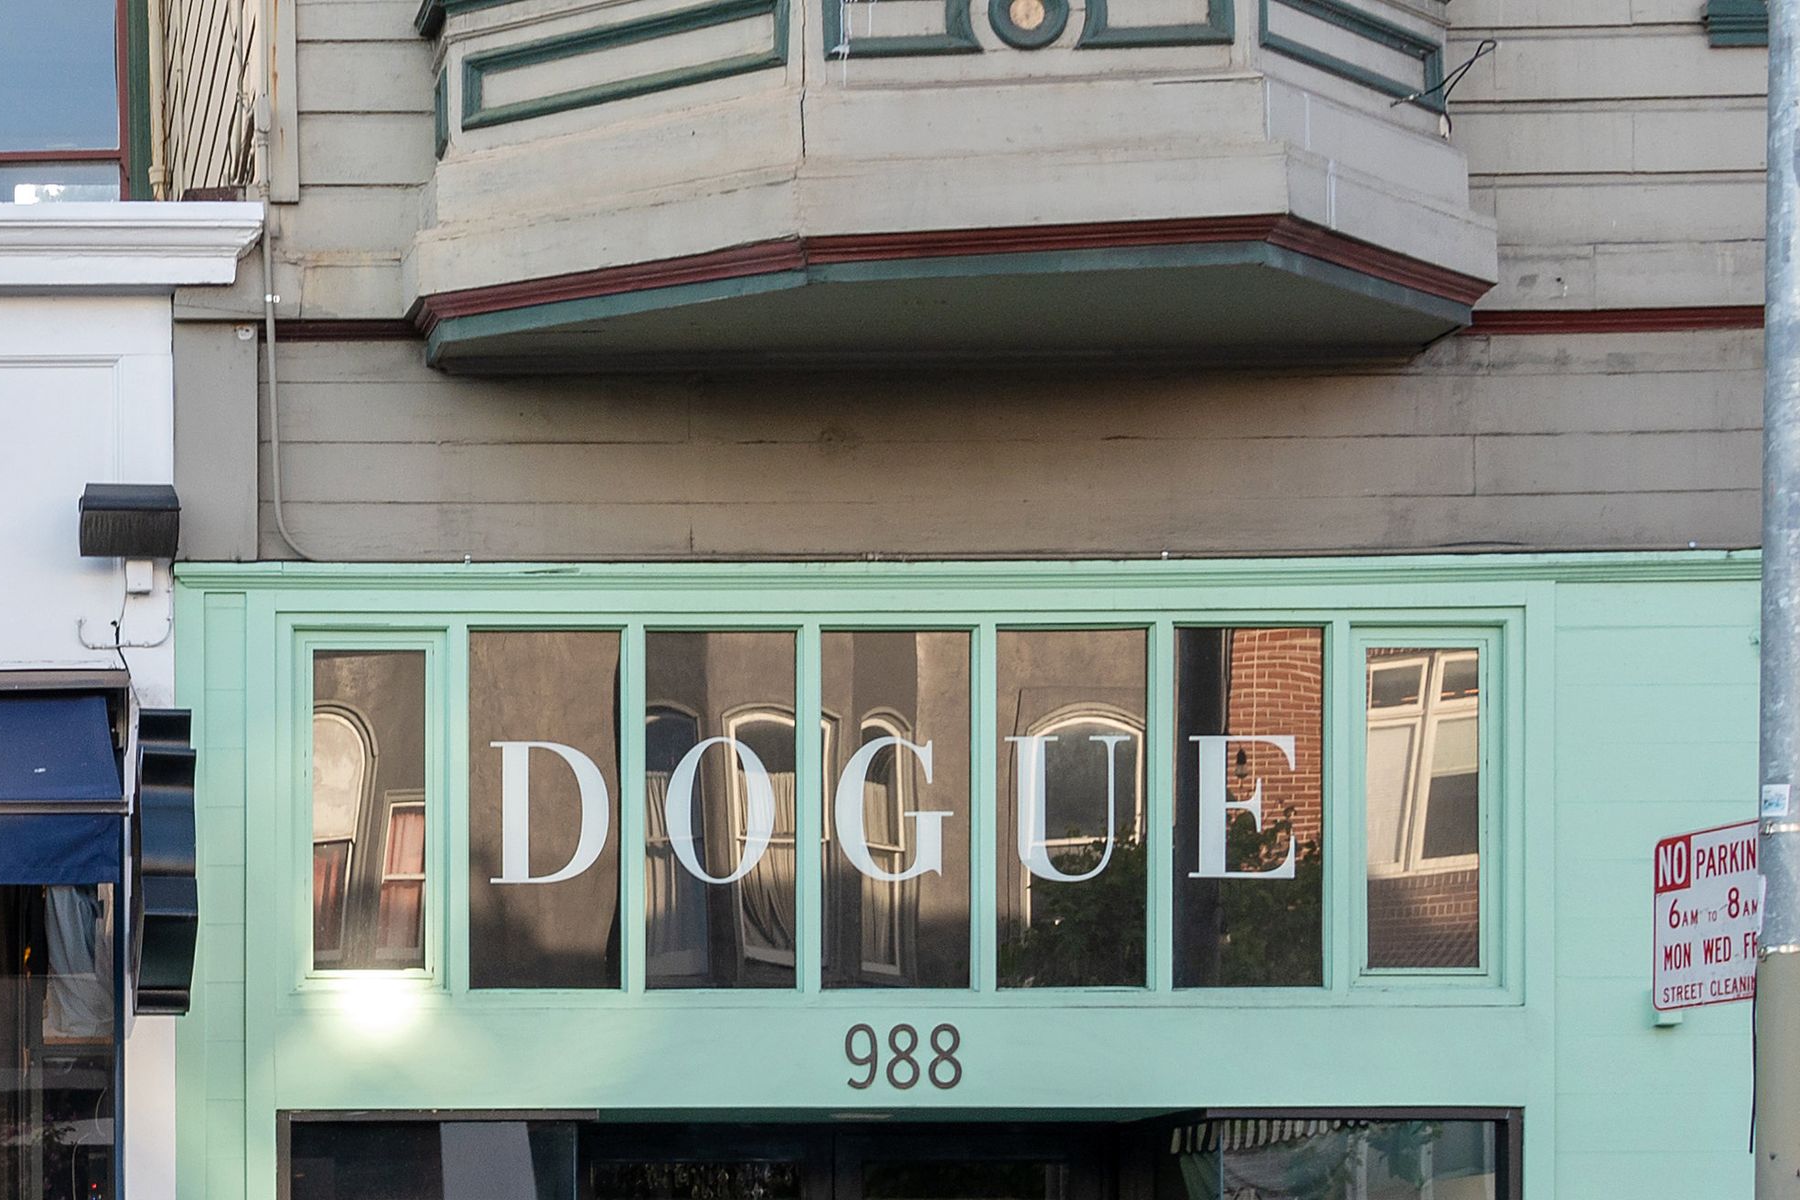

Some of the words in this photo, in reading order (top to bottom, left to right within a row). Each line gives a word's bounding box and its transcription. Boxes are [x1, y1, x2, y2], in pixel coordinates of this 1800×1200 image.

[490, 736, 1297, 885] DOGUE
[1659, 840, 1687, 888] NO
[1697, 838, 1757, 880] PARKIN
[1708, 911, 1718, 922] TO
[1664, 942, 1692, 972] MON
[1703, 936, 1732, 965] WED
[1744, 932, 1758, 959] FR
[1663, 982, 1704, 1004] STREET
[845, 1023, 963, 1090] 988
